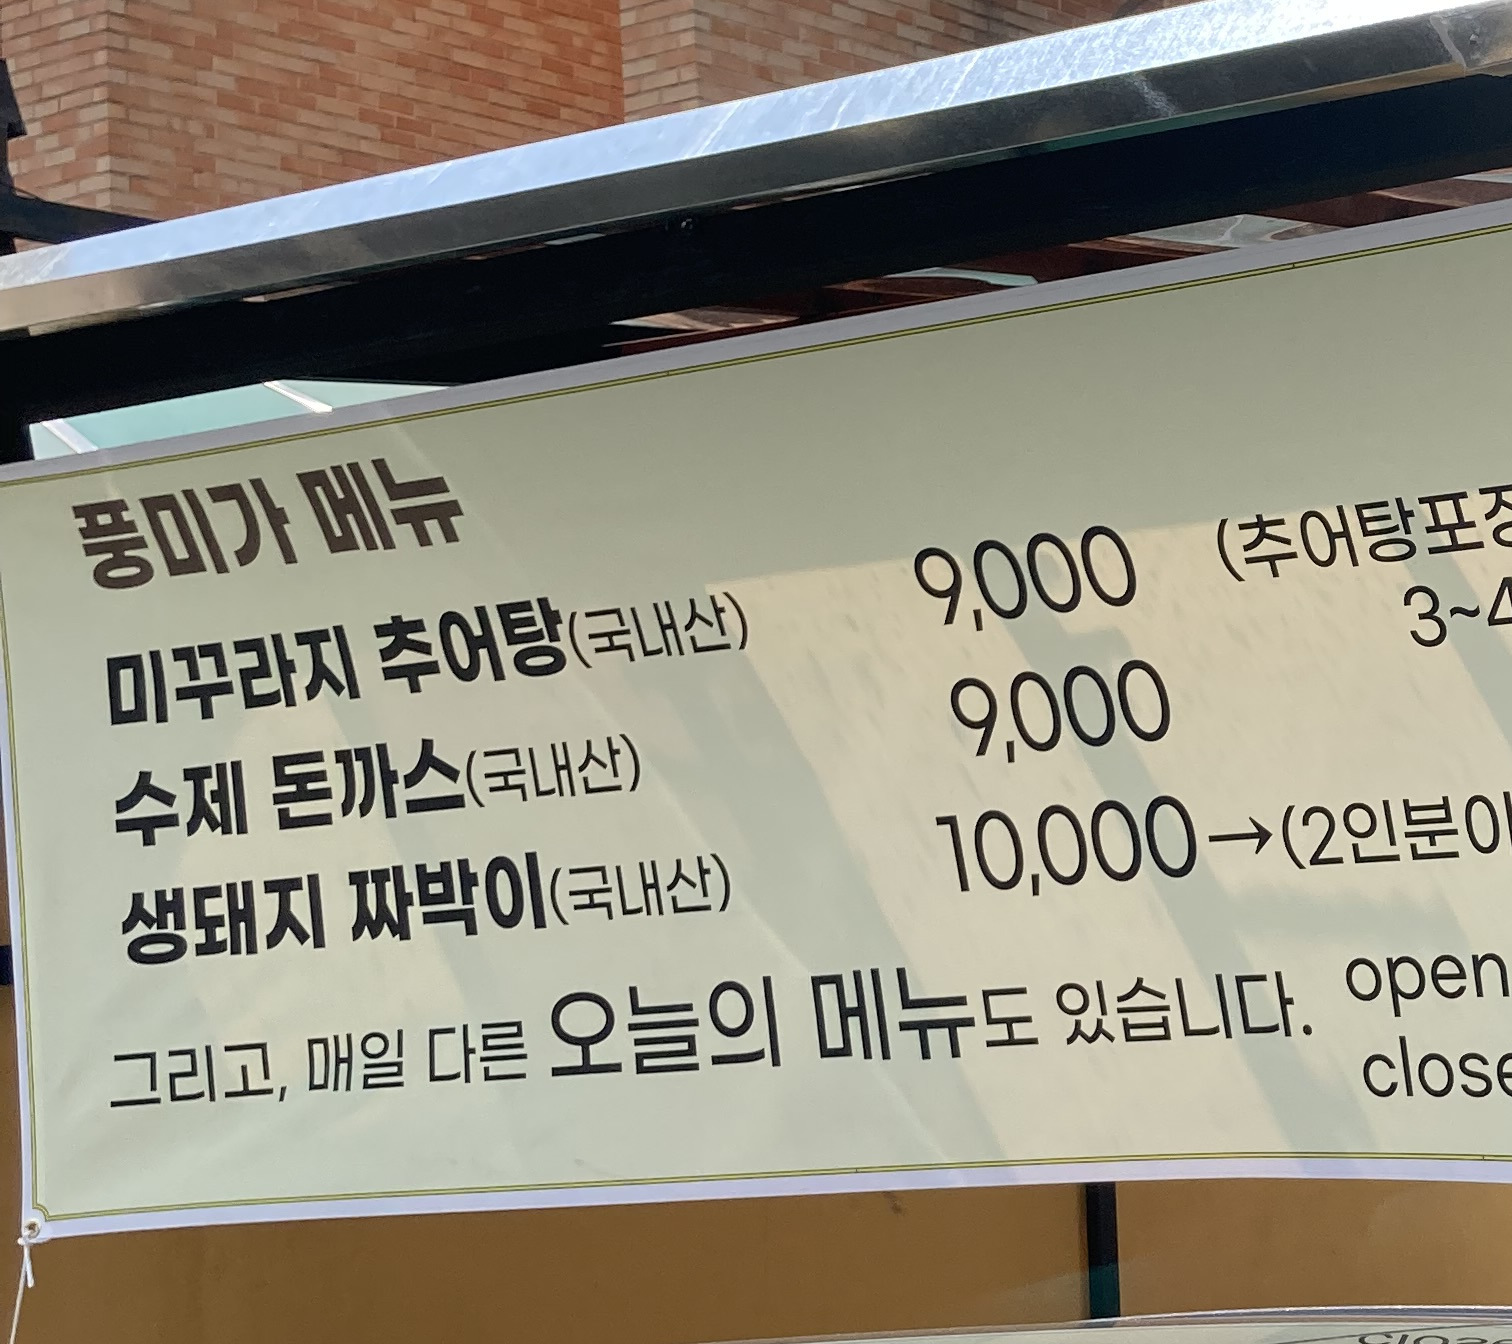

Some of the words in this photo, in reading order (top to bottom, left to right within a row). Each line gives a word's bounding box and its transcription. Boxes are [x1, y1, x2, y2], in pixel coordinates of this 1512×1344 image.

[71, 477, 299, 590] 풍미가
[295, 457, 465, 555] 메뉴
[106, 624, 362, 727] 미꾸라지
[372, 591, 748, 695] 추어탕(국내산)
[913, 525, 1137, 632] 9,000
[114, 759, 249, 848] 수제
[271, 733, 641, 831] 돈까스(국내산)
[950, 659, 1171, 764] 9,000
[121, 872, 326, 966] 생돼지
[347, 850, 731, 942] 짜박이(국내산)
[935, 794, 1198, 897] 10,000
[109, 1041, 288, 1108] 그리고,
[306, 1028, 405, 1093] 매일
[428, 1020, 529, 1084] 다른
[550, 975, 782, 1078] 오늘의
[810, 966, 1040, 1061] 메뉴도
[1055, 970, 1313, 1046] 있습니다.
[1345, 952, 1510, 1018] open
